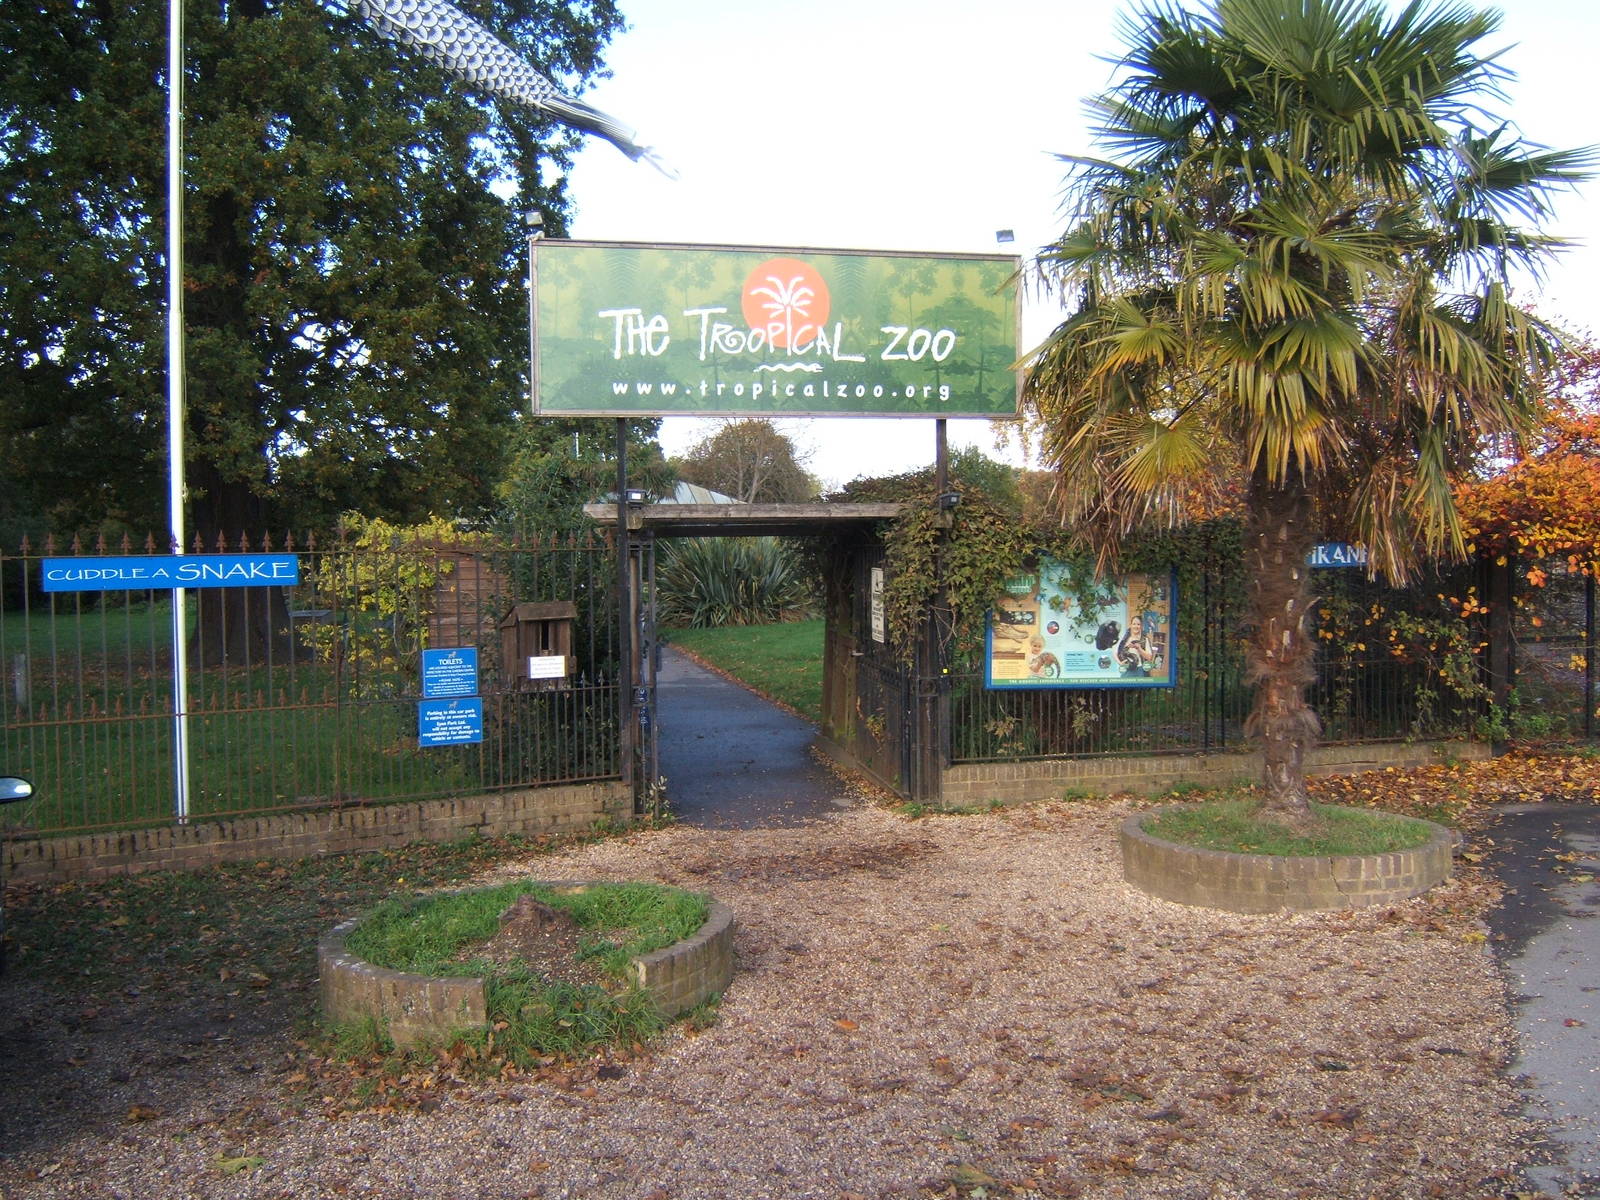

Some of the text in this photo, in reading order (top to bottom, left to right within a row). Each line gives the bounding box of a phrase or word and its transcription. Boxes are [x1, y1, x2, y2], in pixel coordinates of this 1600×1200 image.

[683, 307, 866, 362] TROPICAL
[880, 325, 956, 362] ZOO
[612, 379, 950, 401] www.tropicalzoo.org
[47, 561, 295, 581] CUDDLE A SNAKE
[439, 658, 463, 666] TOILETS
